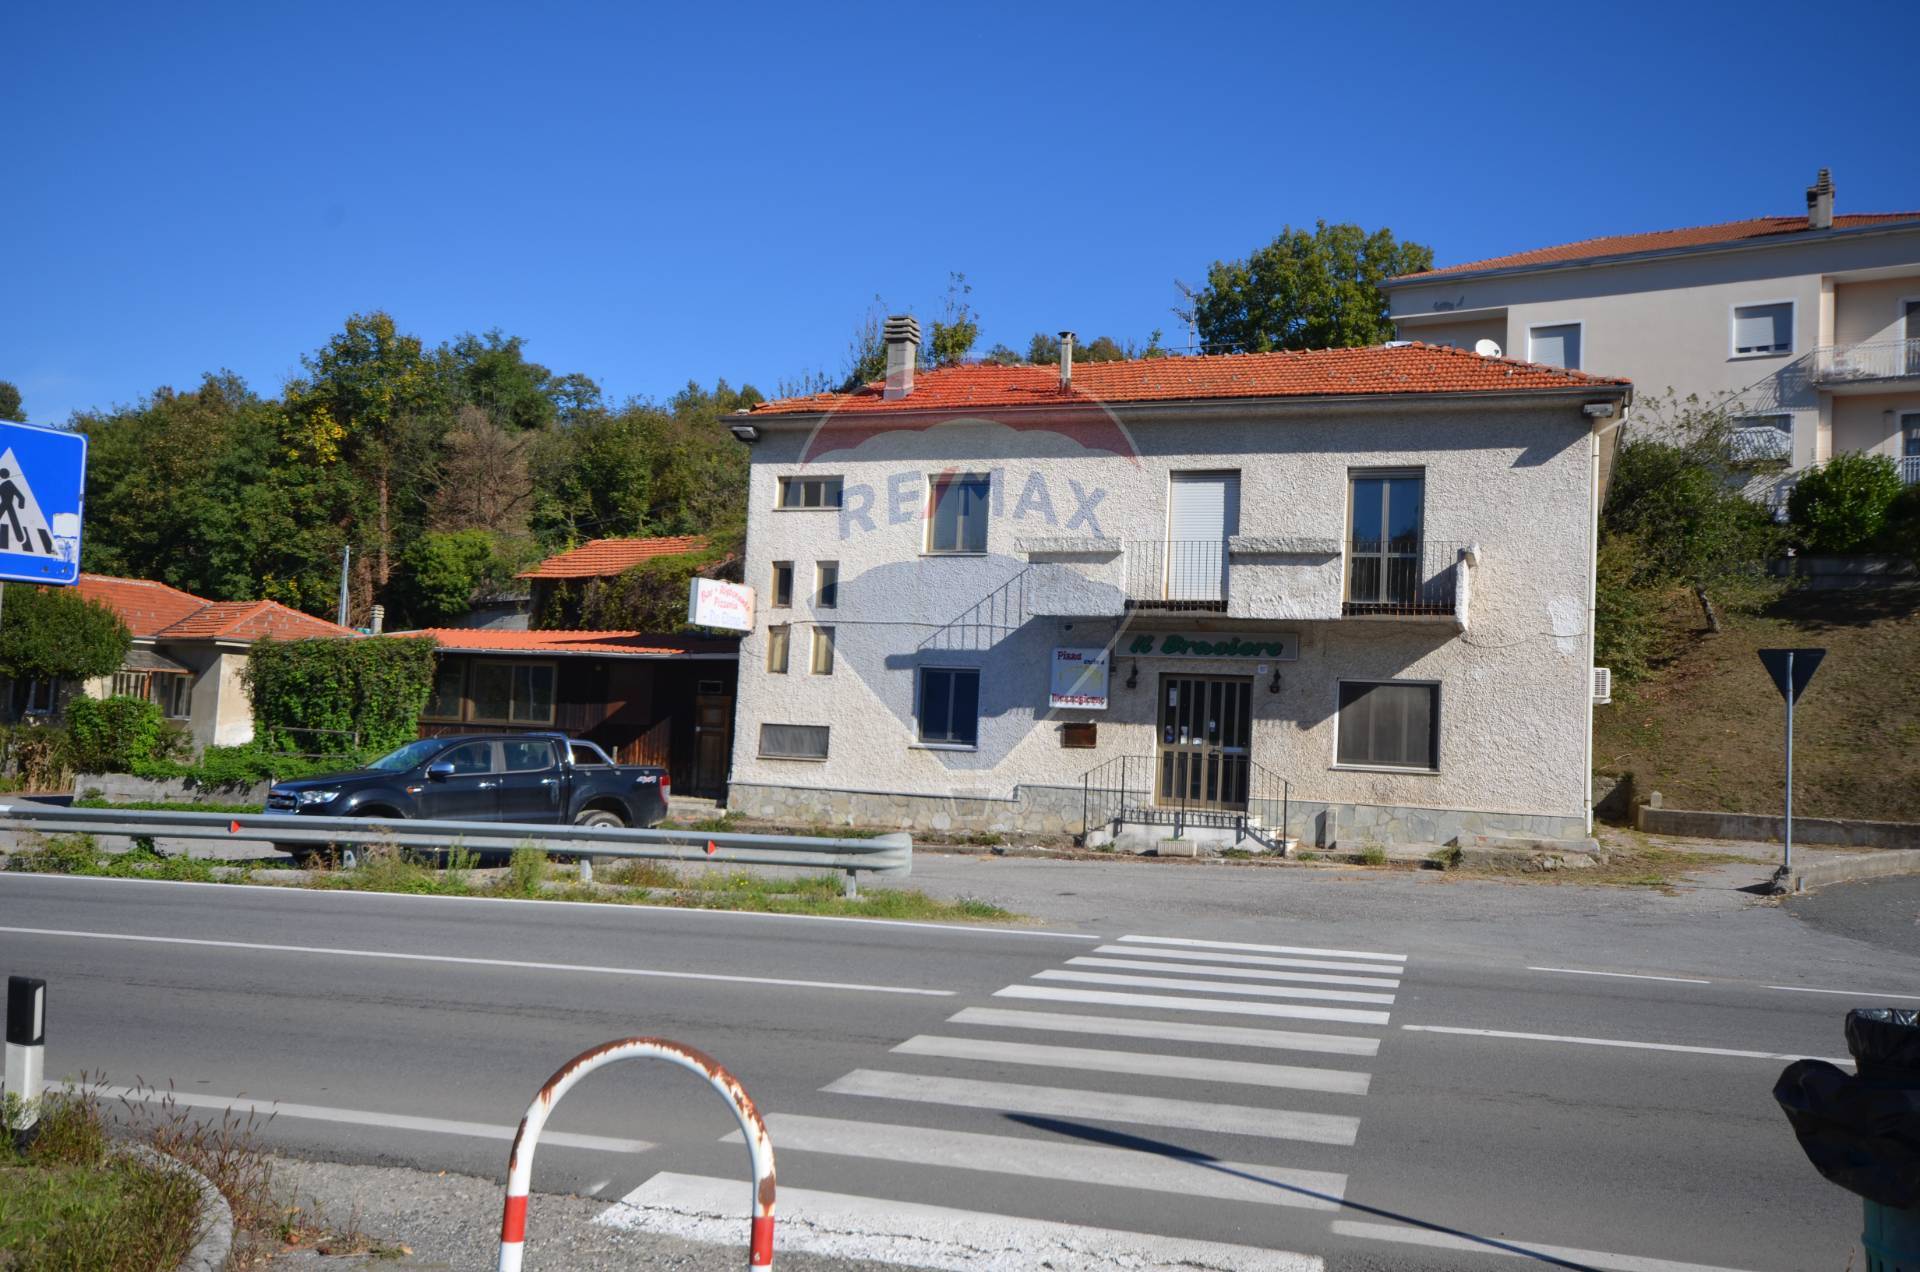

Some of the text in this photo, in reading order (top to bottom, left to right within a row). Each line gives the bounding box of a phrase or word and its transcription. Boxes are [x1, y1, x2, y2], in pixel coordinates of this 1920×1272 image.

[1130, 634, 1284, 657] Il Braciere
[1057, 650, 1082, 661] Pizza
